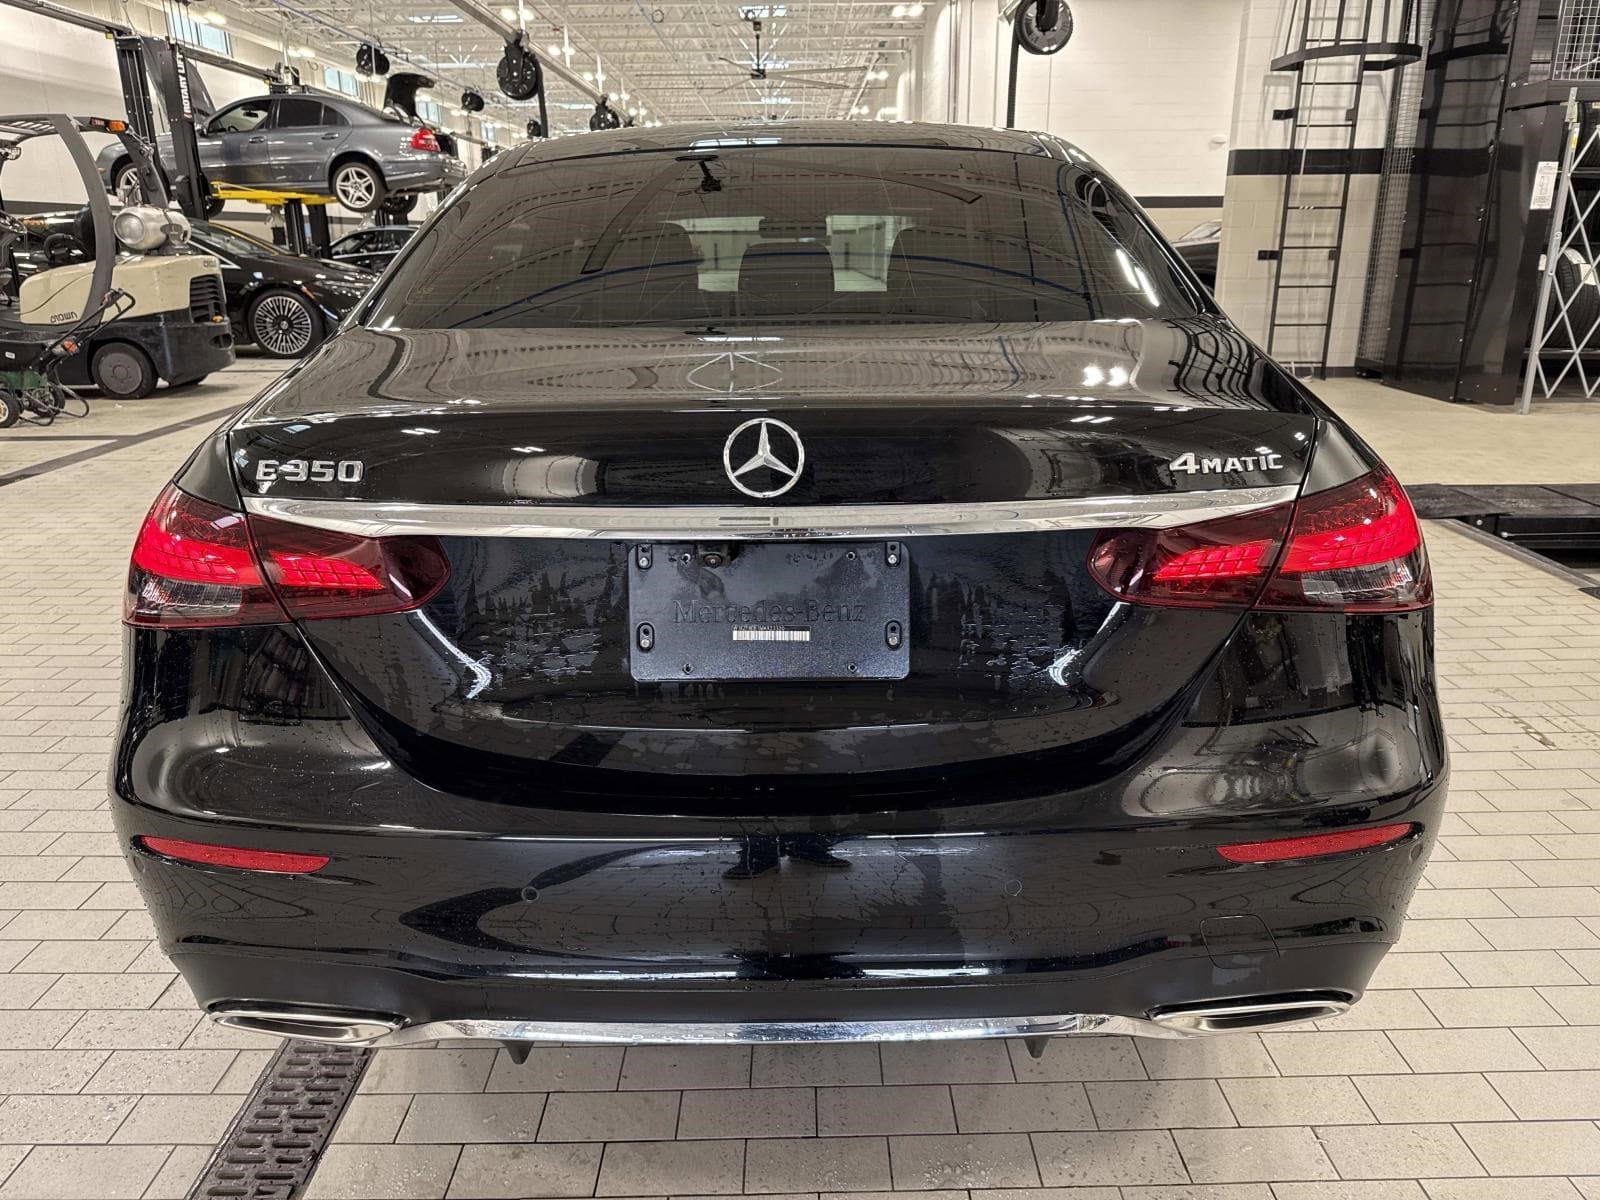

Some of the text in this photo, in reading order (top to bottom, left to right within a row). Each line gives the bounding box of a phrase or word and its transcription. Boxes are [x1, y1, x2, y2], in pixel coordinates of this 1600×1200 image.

[178, 75, 192, 113] ROTARY
[1169, 452, 1283, 474] 4MATIC
[672, 599, 866, 623] Mercedes-Benz
